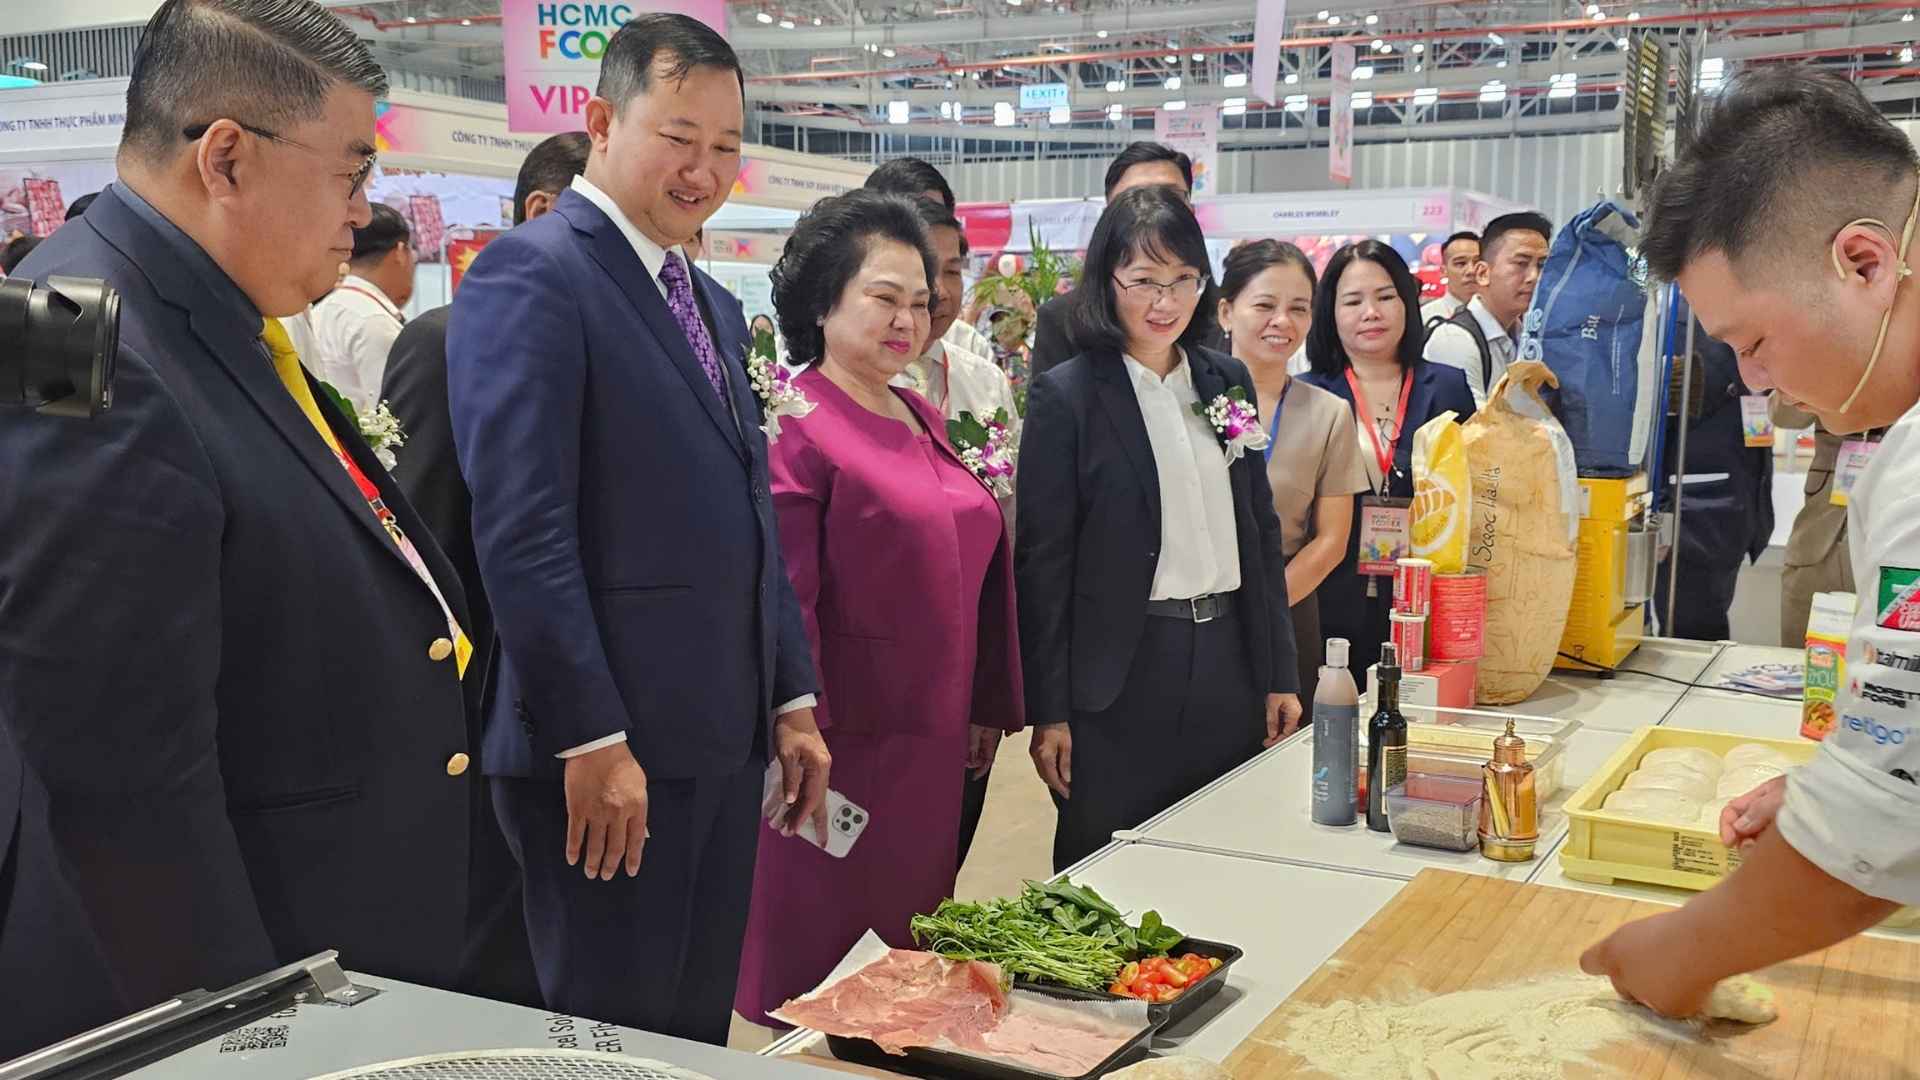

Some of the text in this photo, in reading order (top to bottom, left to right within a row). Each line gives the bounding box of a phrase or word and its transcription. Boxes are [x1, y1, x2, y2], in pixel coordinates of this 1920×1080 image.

[538, 4, 632, 27] HCMC
[529, 84, 590, 115] VIP
[1031, 88, 1057, 98] EXIT
[28, 118, 53, 130] TNHH
[452, 129, 478, 144] CÔNG
[478, 134, 488, 146] TY
[489, 136, 513, 150] TNHH
[1842, 714, 1904, 745] retigo
